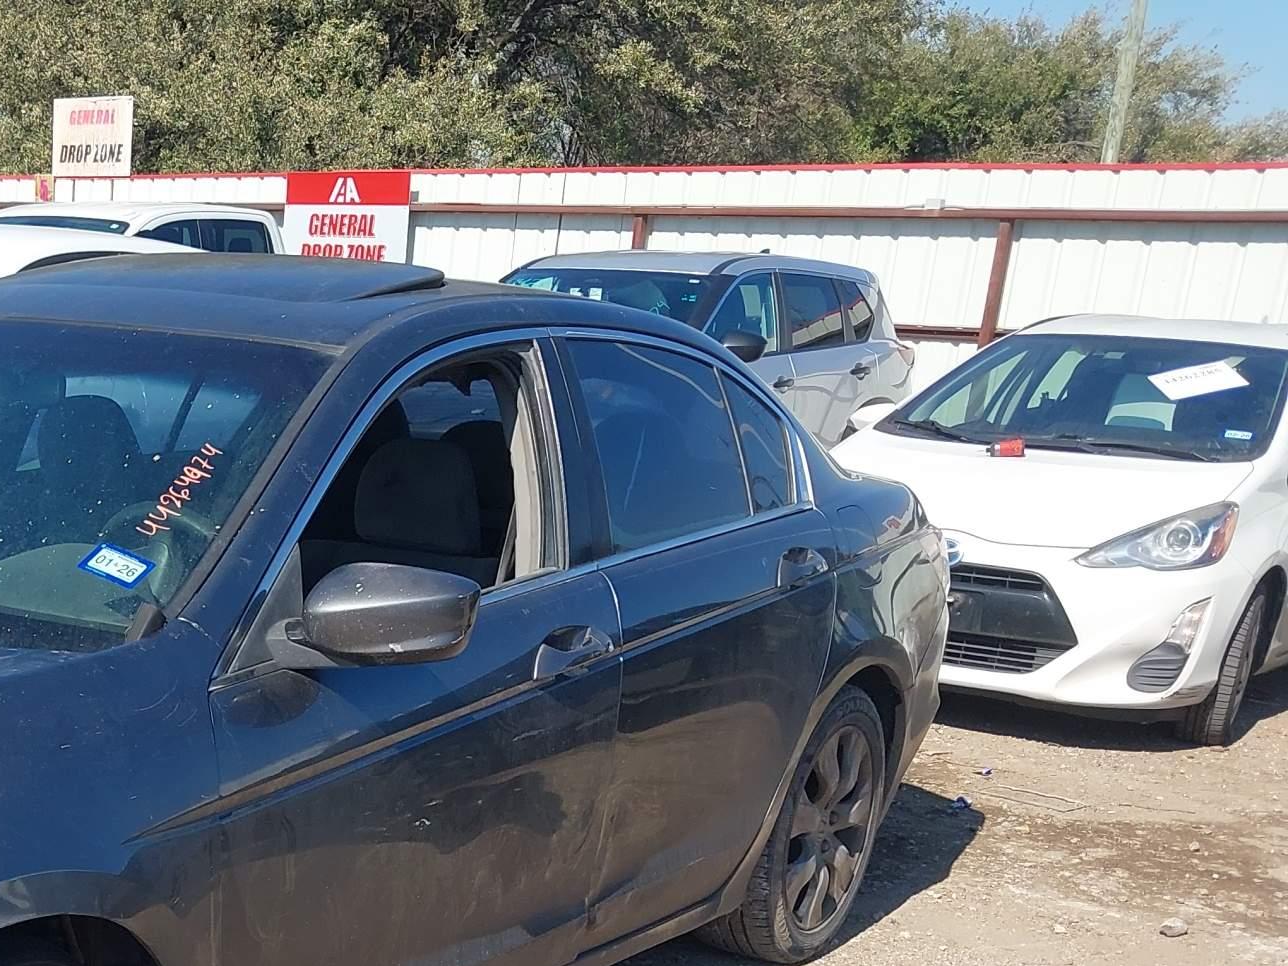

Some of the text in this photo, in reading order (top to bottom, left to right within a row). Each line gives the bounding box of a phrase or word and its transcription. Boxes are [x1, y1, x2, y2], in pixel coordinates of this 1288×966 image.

[69, 109, 116, 125] GENERAL
[59, 143, 124, 163] DROP ZONE
[308, 213, 376, 237] GENERAL
[136, 443, 223, 536] 44264974
